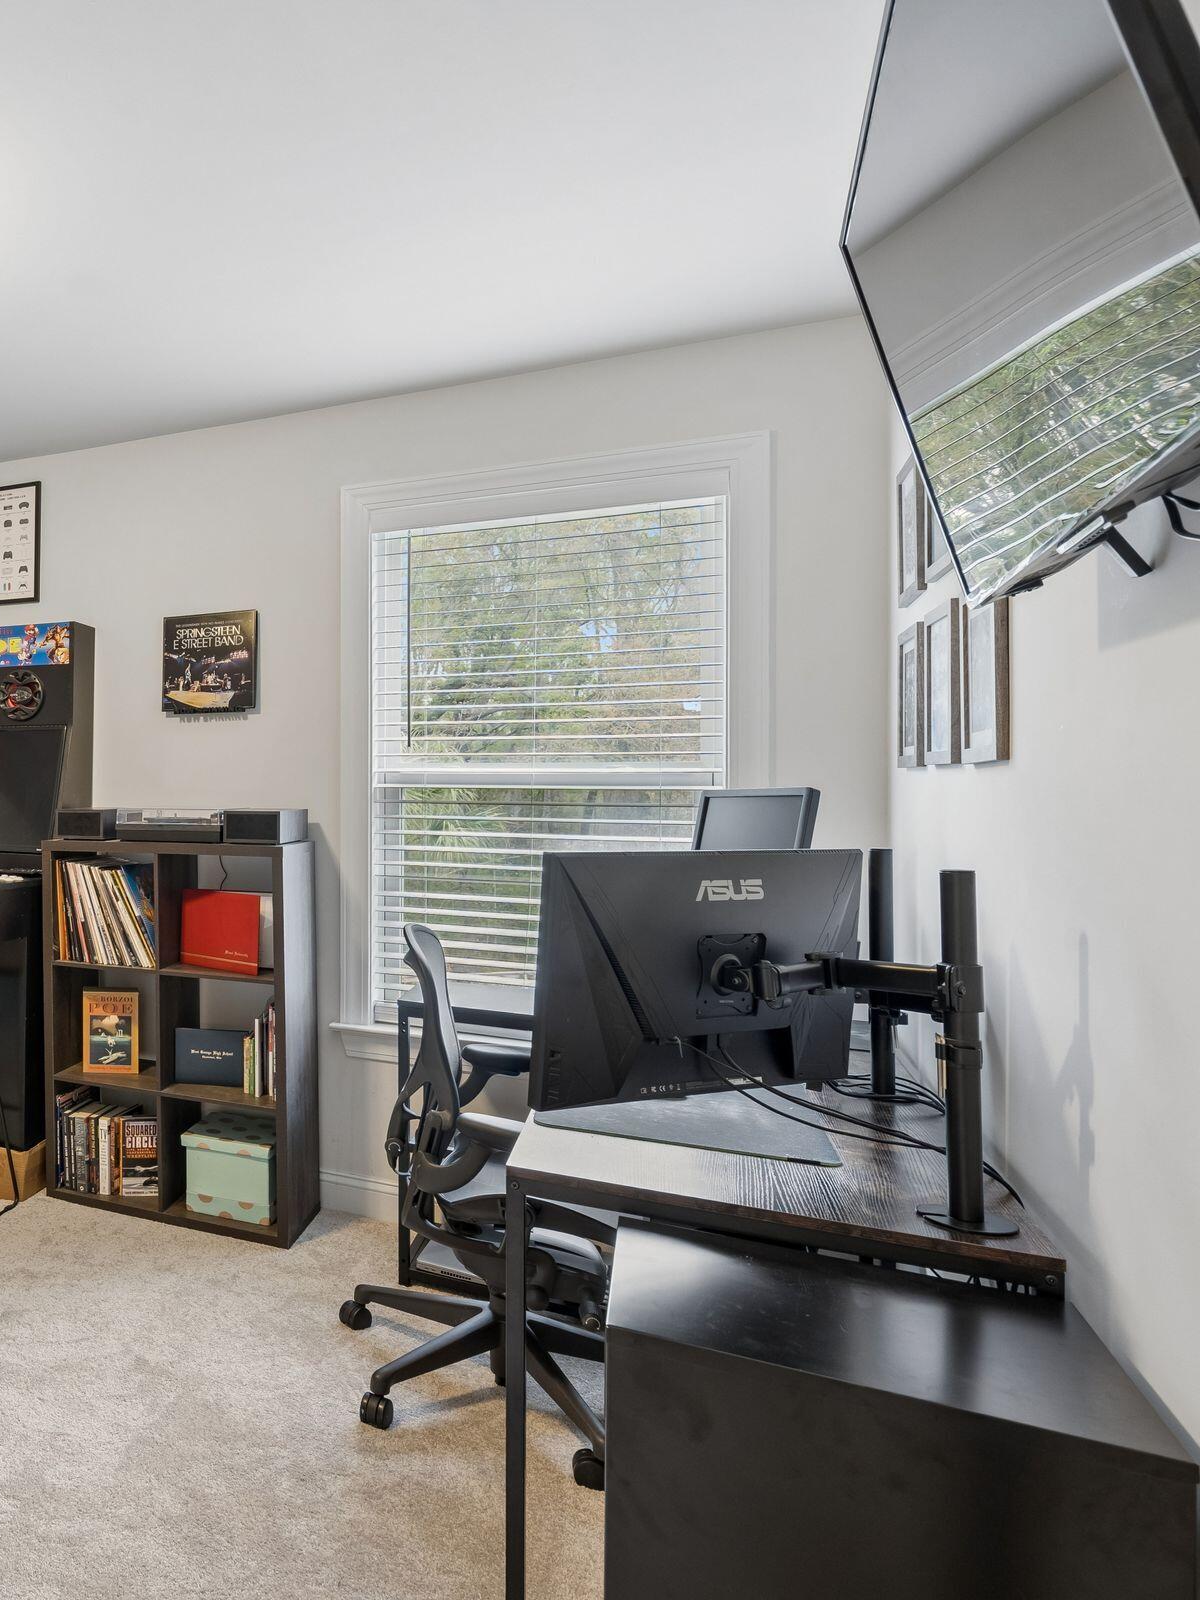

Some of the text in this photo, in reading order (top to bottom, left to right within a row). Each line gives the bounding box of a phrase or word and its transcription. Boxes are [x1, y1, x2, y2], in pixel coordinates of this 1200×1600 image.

[176, 625, 241, 640] SPRINGSTEEN
[173, 635, 244, 650] E STREET BAND
[695, 878, 764, 901] ASUS
[87, 1002, 133, 1014] POE
[126, 1124, 157, 1137] SQUARED
[126, 1136, 157, 1149] CIRCLE
